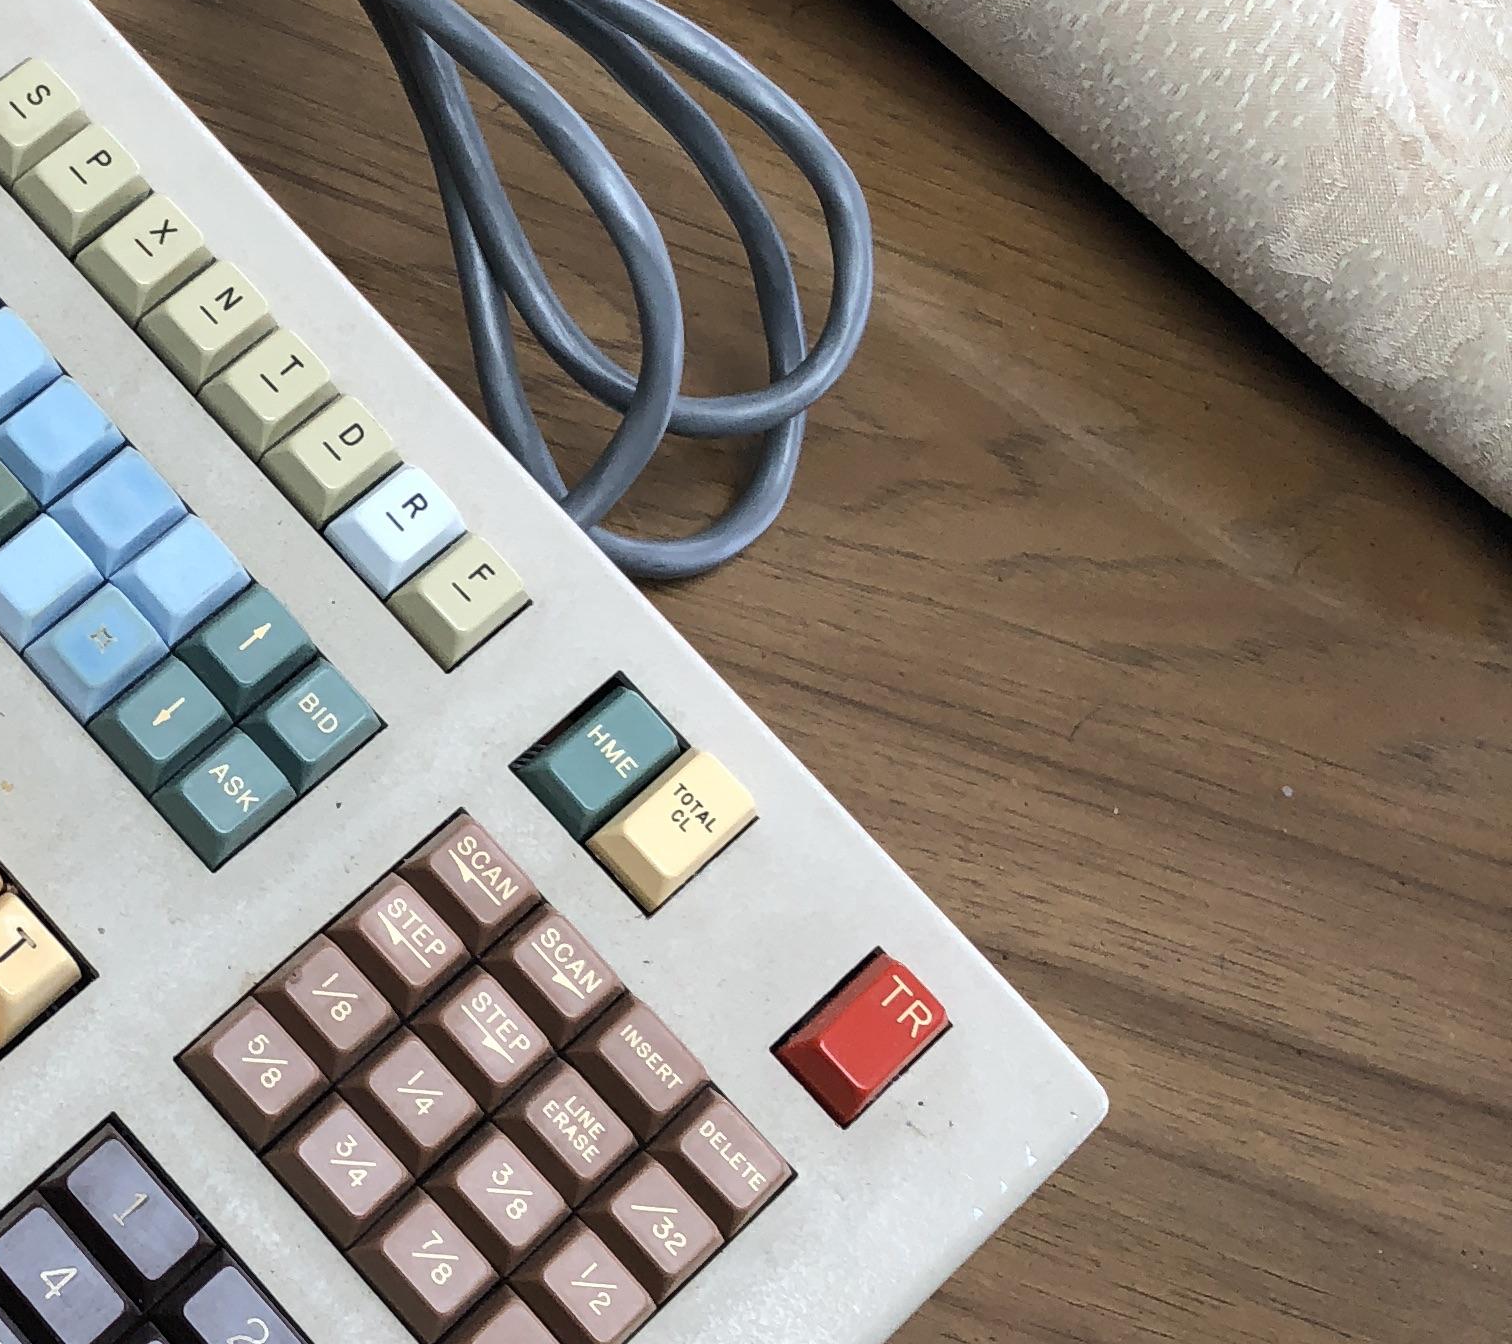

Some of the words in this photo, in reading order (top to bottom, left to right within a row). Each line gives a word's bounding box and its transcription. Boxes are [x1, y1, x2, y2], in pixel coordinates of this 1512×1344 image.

[26, 84, 51, 106] S
[86, 149, 112, 167] P
[150, 219, 178, 244] X
[280, 354, 304, 376] T
[339, 423, 365, 446] D
[401, 492, 428, 520] R
[468, 563, 496, 581] F
[297, 692, 338, 734] BID
[587, 724, 639, 779] HME
[208, 763, 259, 813] ASK
[673, 783, 716, 833] TOTAL
[670, 809, 691, 833] CL
[457, 835, 520, 901] SCAN
[386, 897, 447, 957] STEP
[539, 928, 603, 994] SCAN
[471, 991, 531, 1053] STEP
[879, 974, 933, 1040] TR
[241, 1033, 289, 1089] 5/8
[619, 1024, 684, 1092] INSERT
[542, 1100, 601, 1165] ERASE
[564, 1095, 606, 1141] LINE
[330, 1134, 377, 1188] 3/4
[697, 1119, 767, 1193] DELETE
[112, 1192, 150, 1228] 1
[486, 1165, 534, 1221] 3/8
[40, 1266, 78, 1300] 4
[411, 1230, 460, 1286] 7/8
